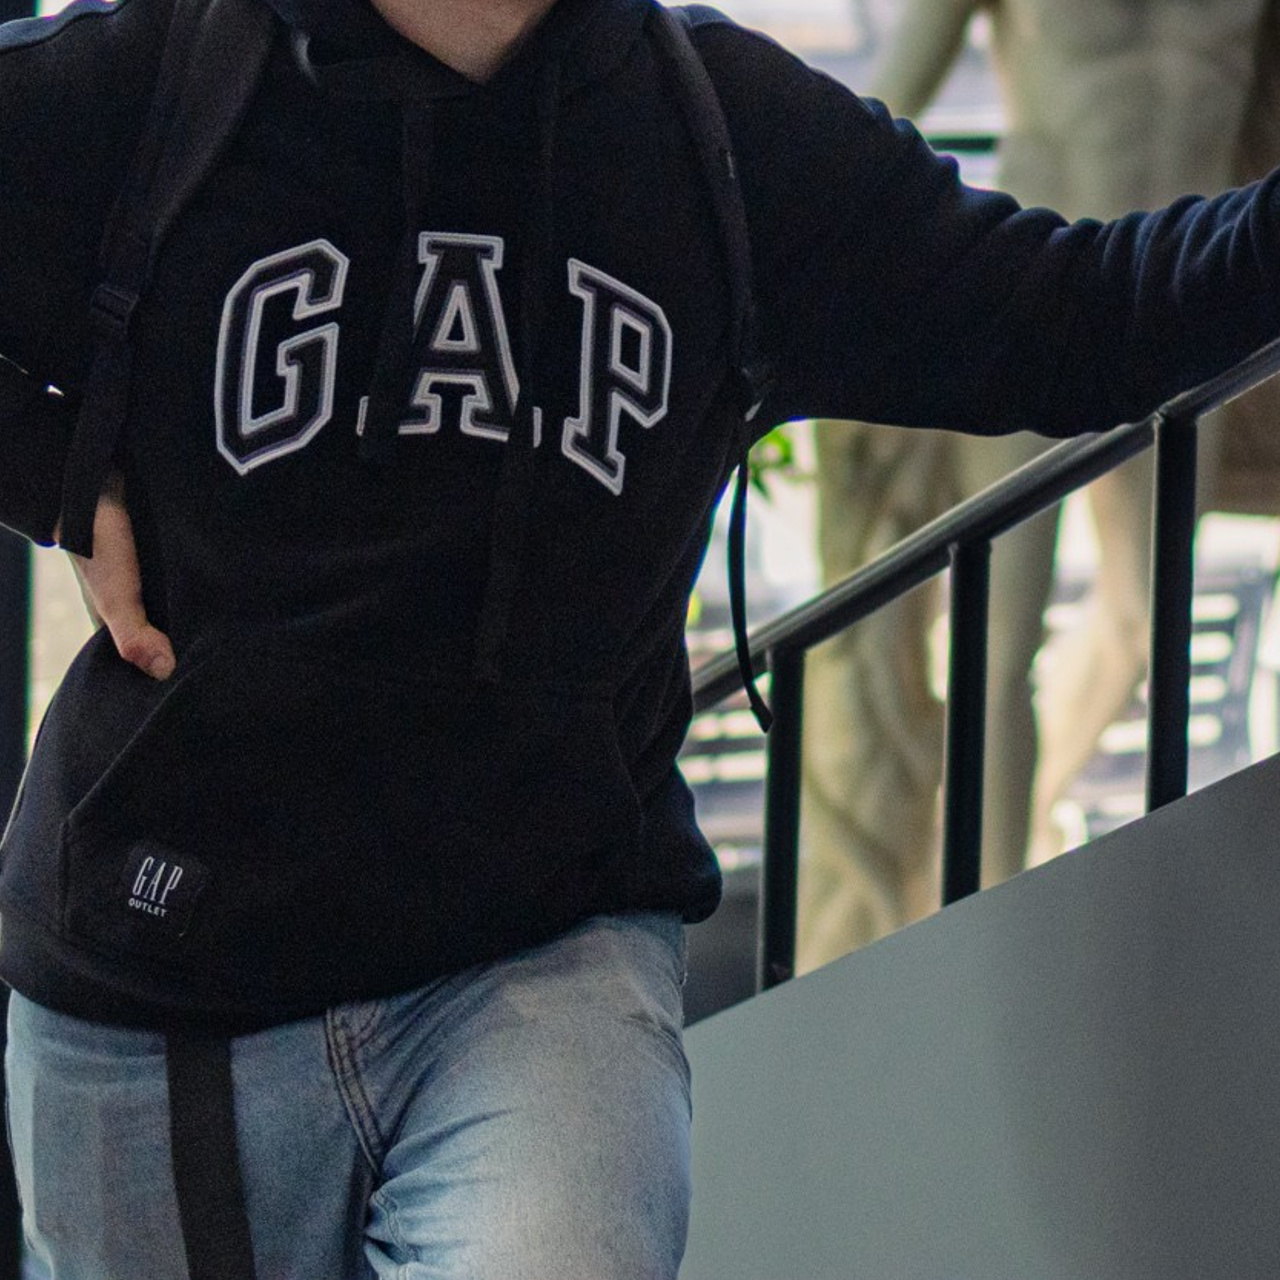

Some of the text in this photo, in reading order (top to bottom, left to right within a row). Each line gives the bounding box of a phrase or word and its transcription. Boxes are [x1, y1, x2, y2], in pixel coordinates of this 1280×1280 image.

[214, 231, 673, 496] GAP
[132, 855, 184, 906] GAP
[128, 897, 168, 918] OUTLET
